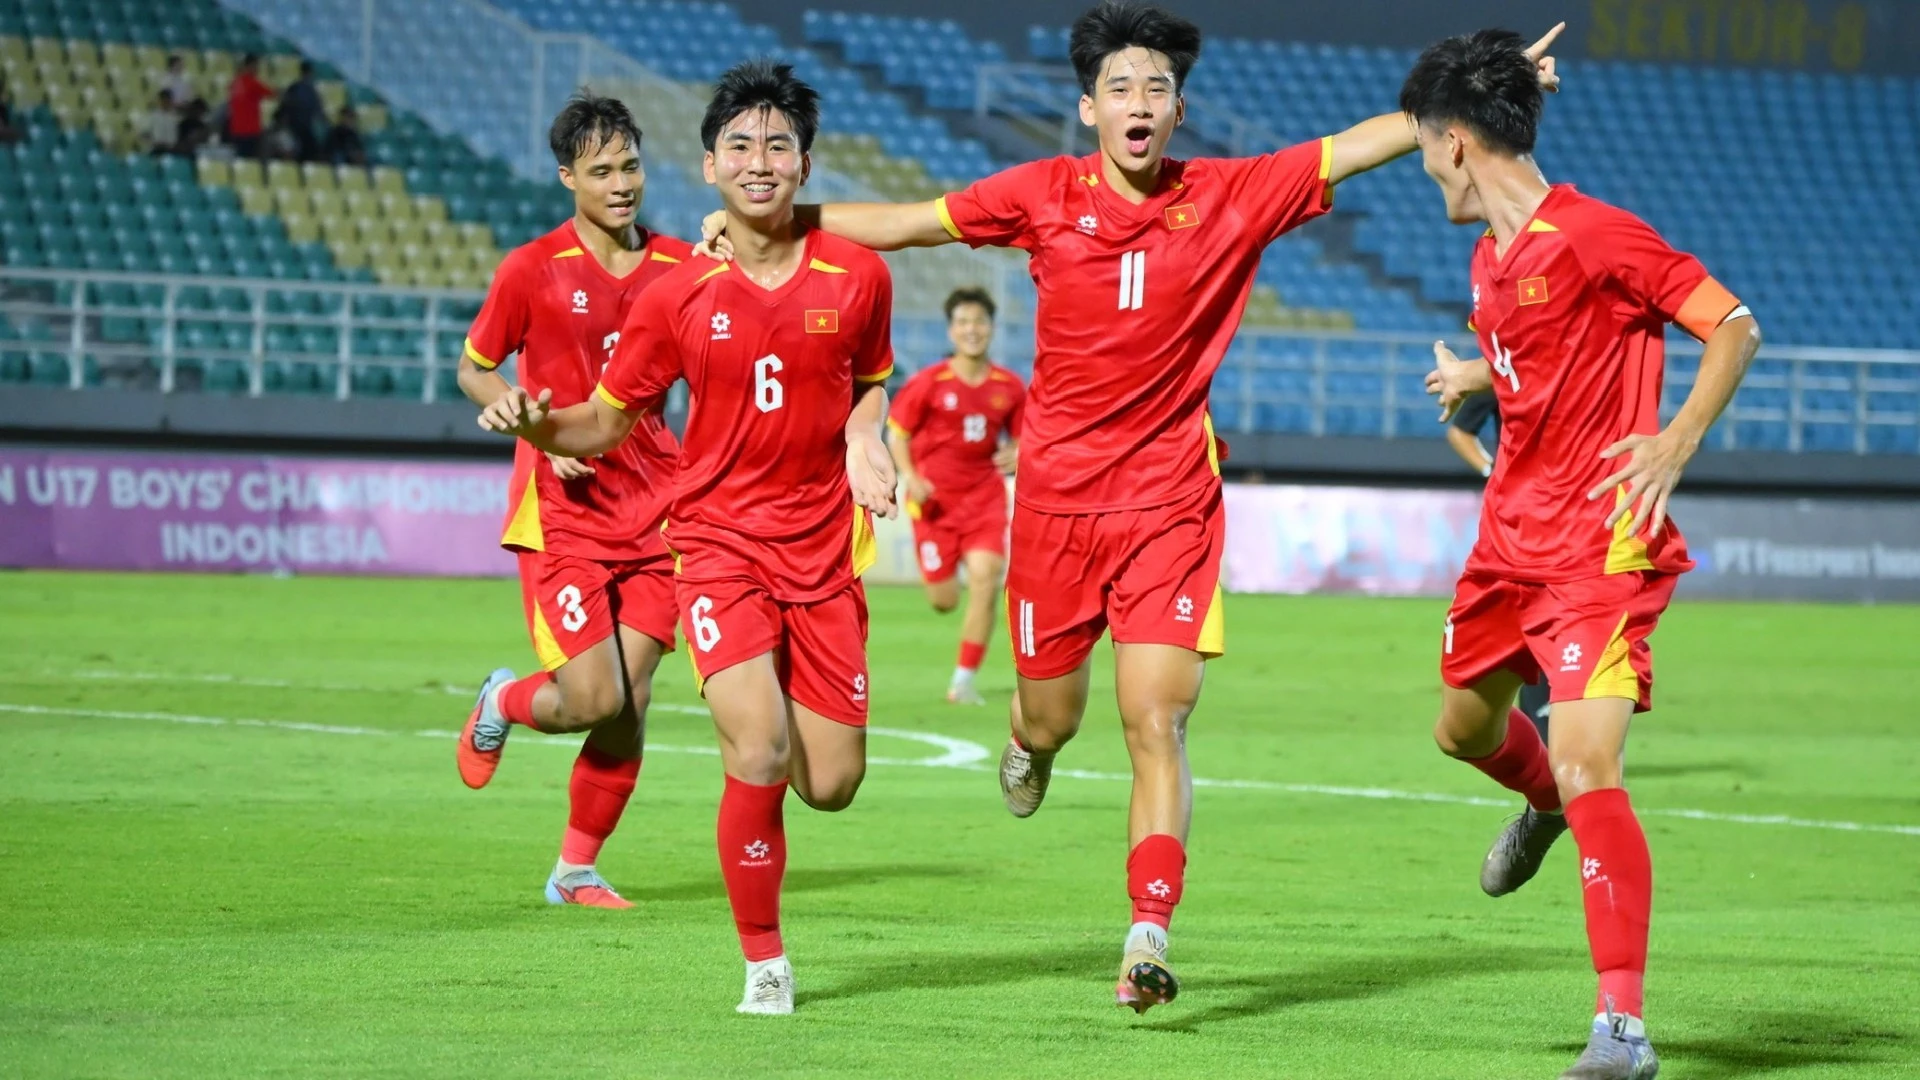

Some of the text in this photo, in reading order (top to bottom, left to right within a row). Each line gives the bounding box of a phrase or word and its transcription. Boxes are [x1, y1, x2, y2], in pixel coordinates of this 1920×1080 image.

[1118, 250, 1145, 311] 11
[755, 353, 783, 413] 6
[1491, 331, 1521, 393] 4
[26, 466, 98, 508] U17
[108, 468, 231, 511] BOYS'
[161, 522, 388, 563] INDONESIA
[556, 584, 588, 632] 3
[690, 596, 721, 652] 6
[1020, 599, 1036, 657] 11
